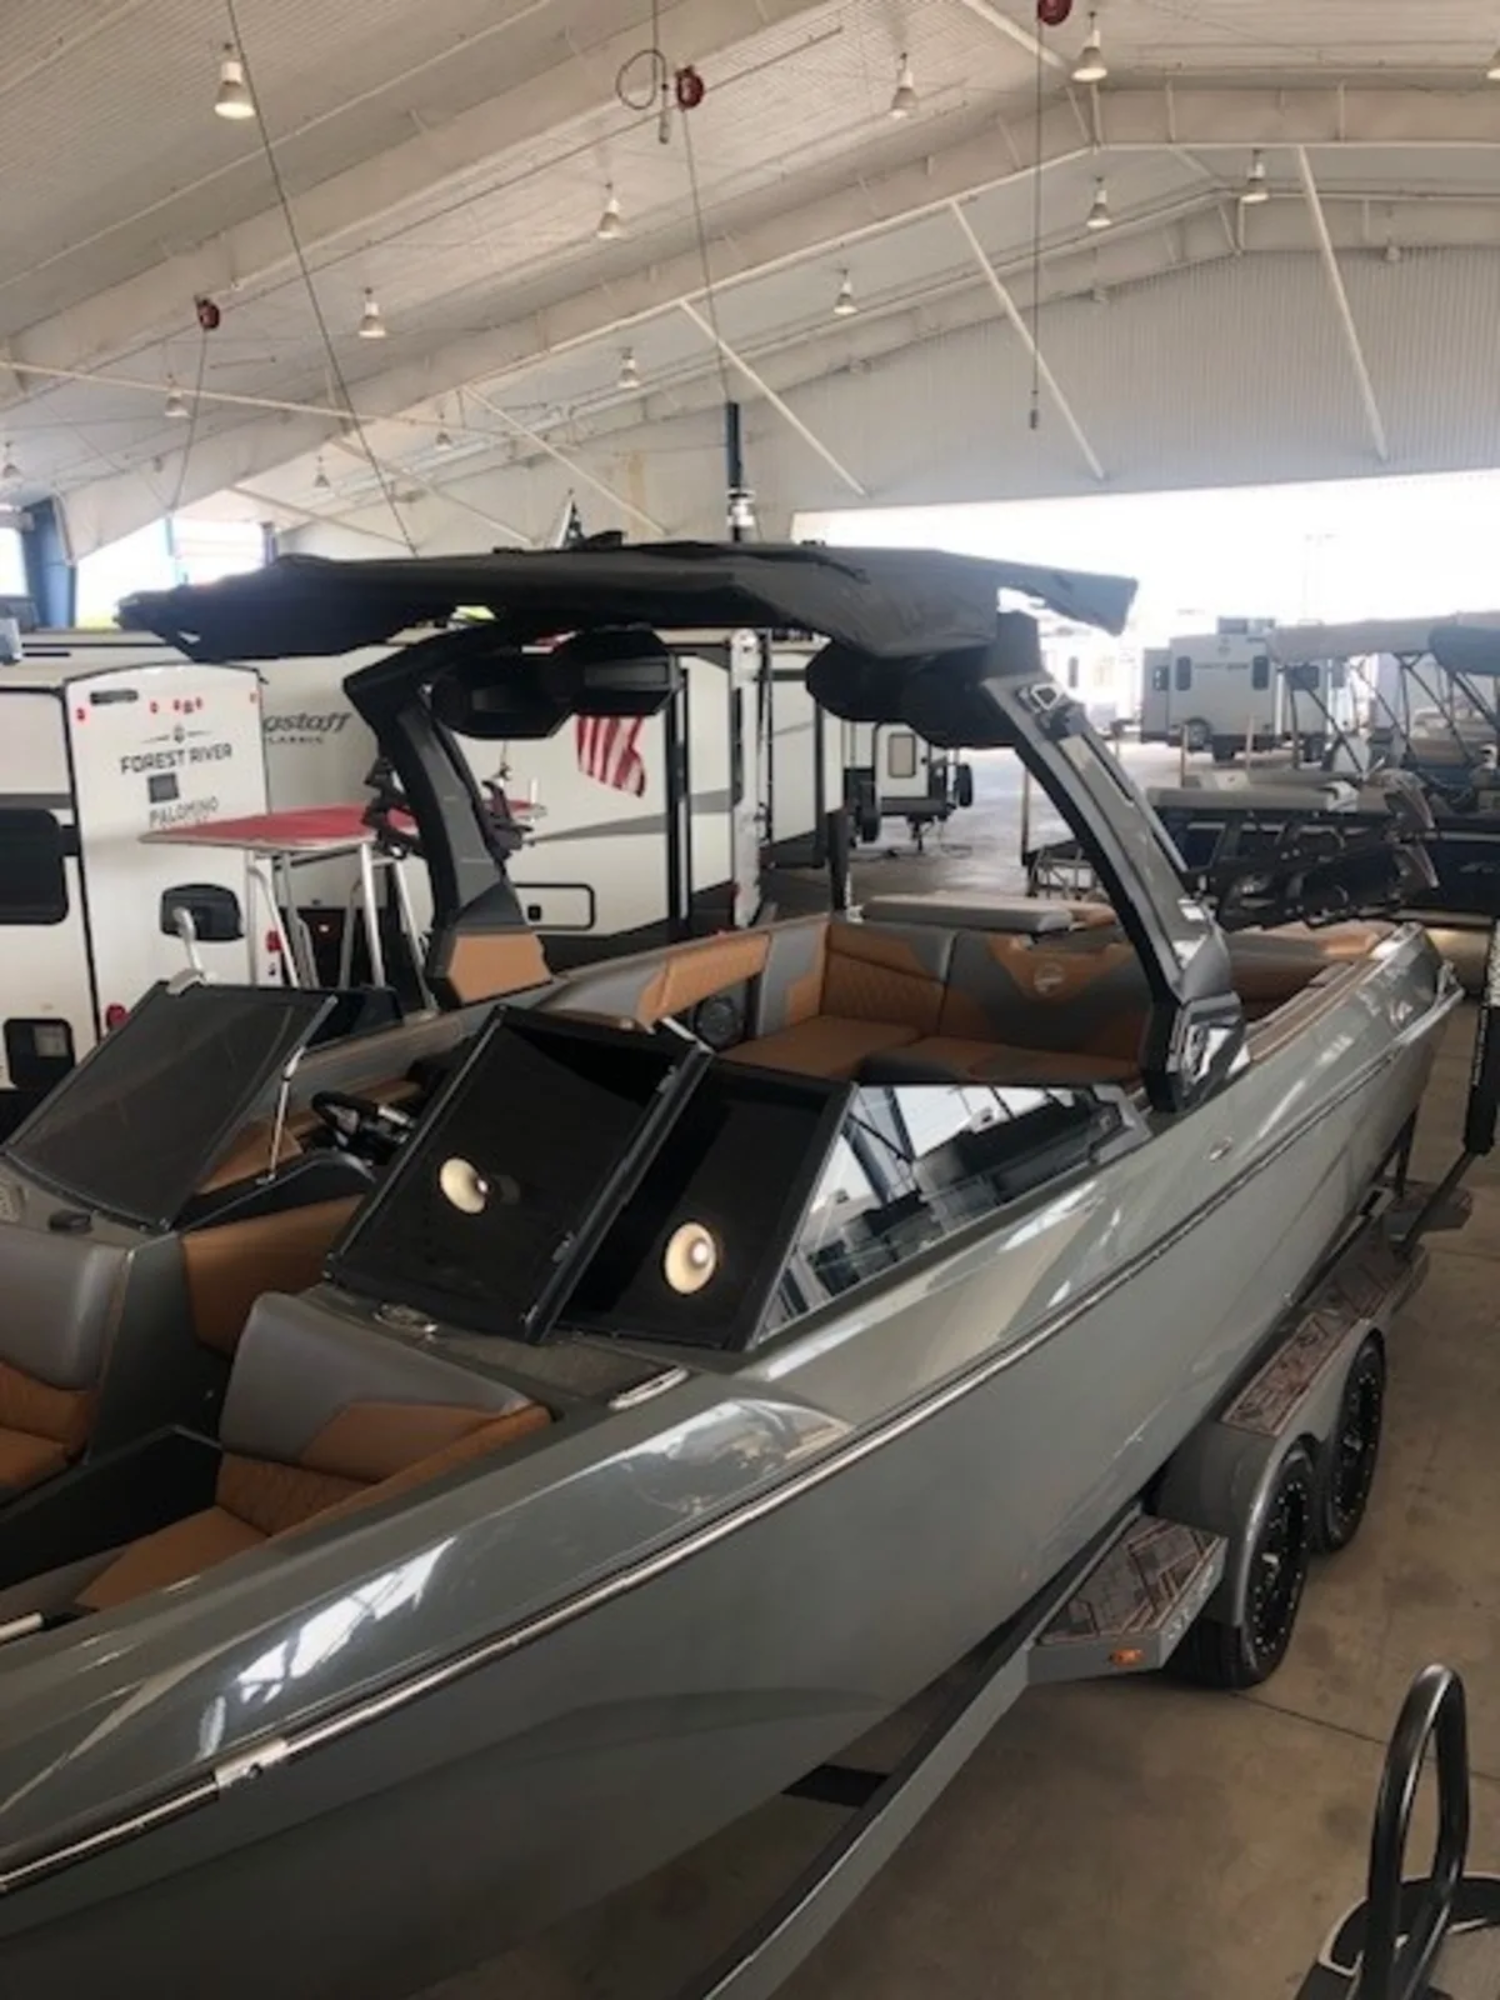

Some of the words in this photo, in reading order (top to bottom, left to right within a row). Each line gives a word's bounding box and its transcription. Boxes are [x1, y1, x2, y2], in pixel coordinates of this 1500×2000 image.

[120, 749, 185, 775] FOREST
[190, 742, 232, 764] RIVER
[149, 796, 218, 828] PALOMINO
